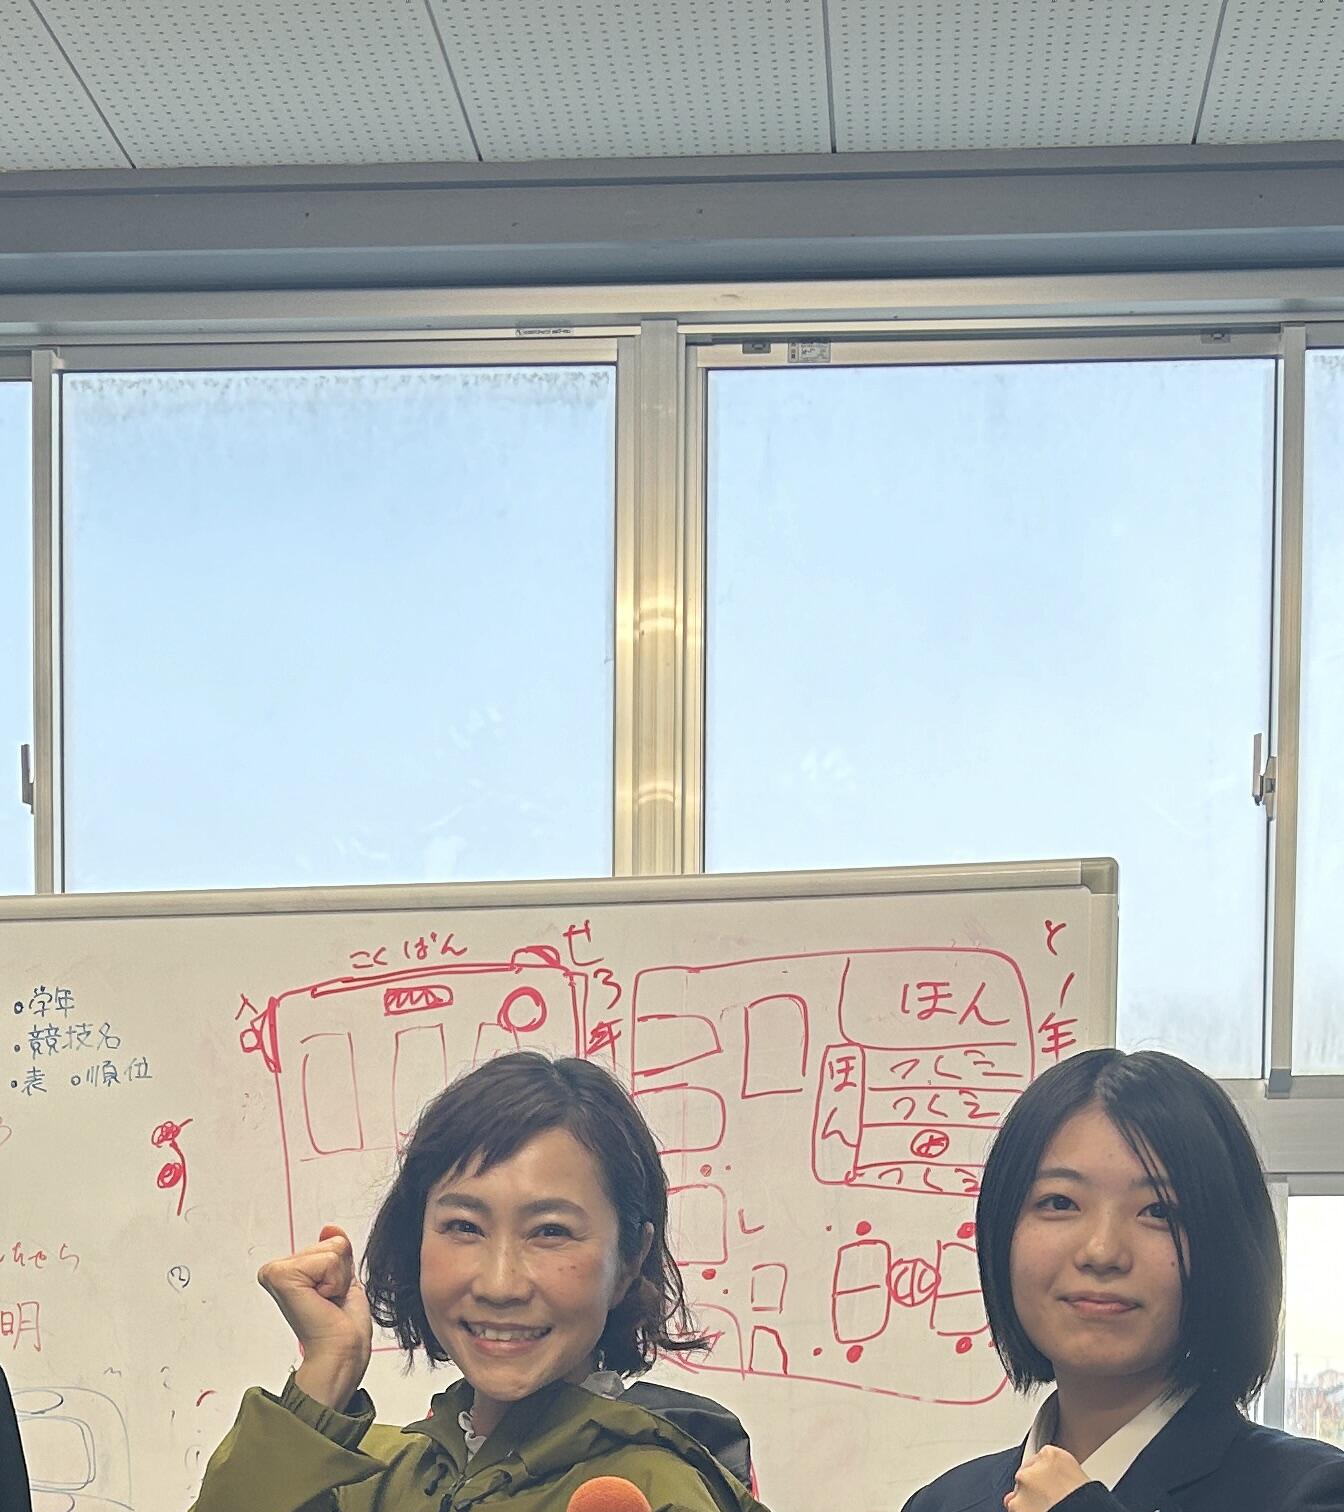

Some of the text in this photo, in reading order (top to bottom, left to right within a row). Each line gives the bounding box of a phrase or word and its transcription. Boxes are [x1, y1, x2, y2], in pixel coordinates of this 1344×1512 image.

[348, 931, 469, 969] こくばん
[900, 981, 1011, 1027] ほん
